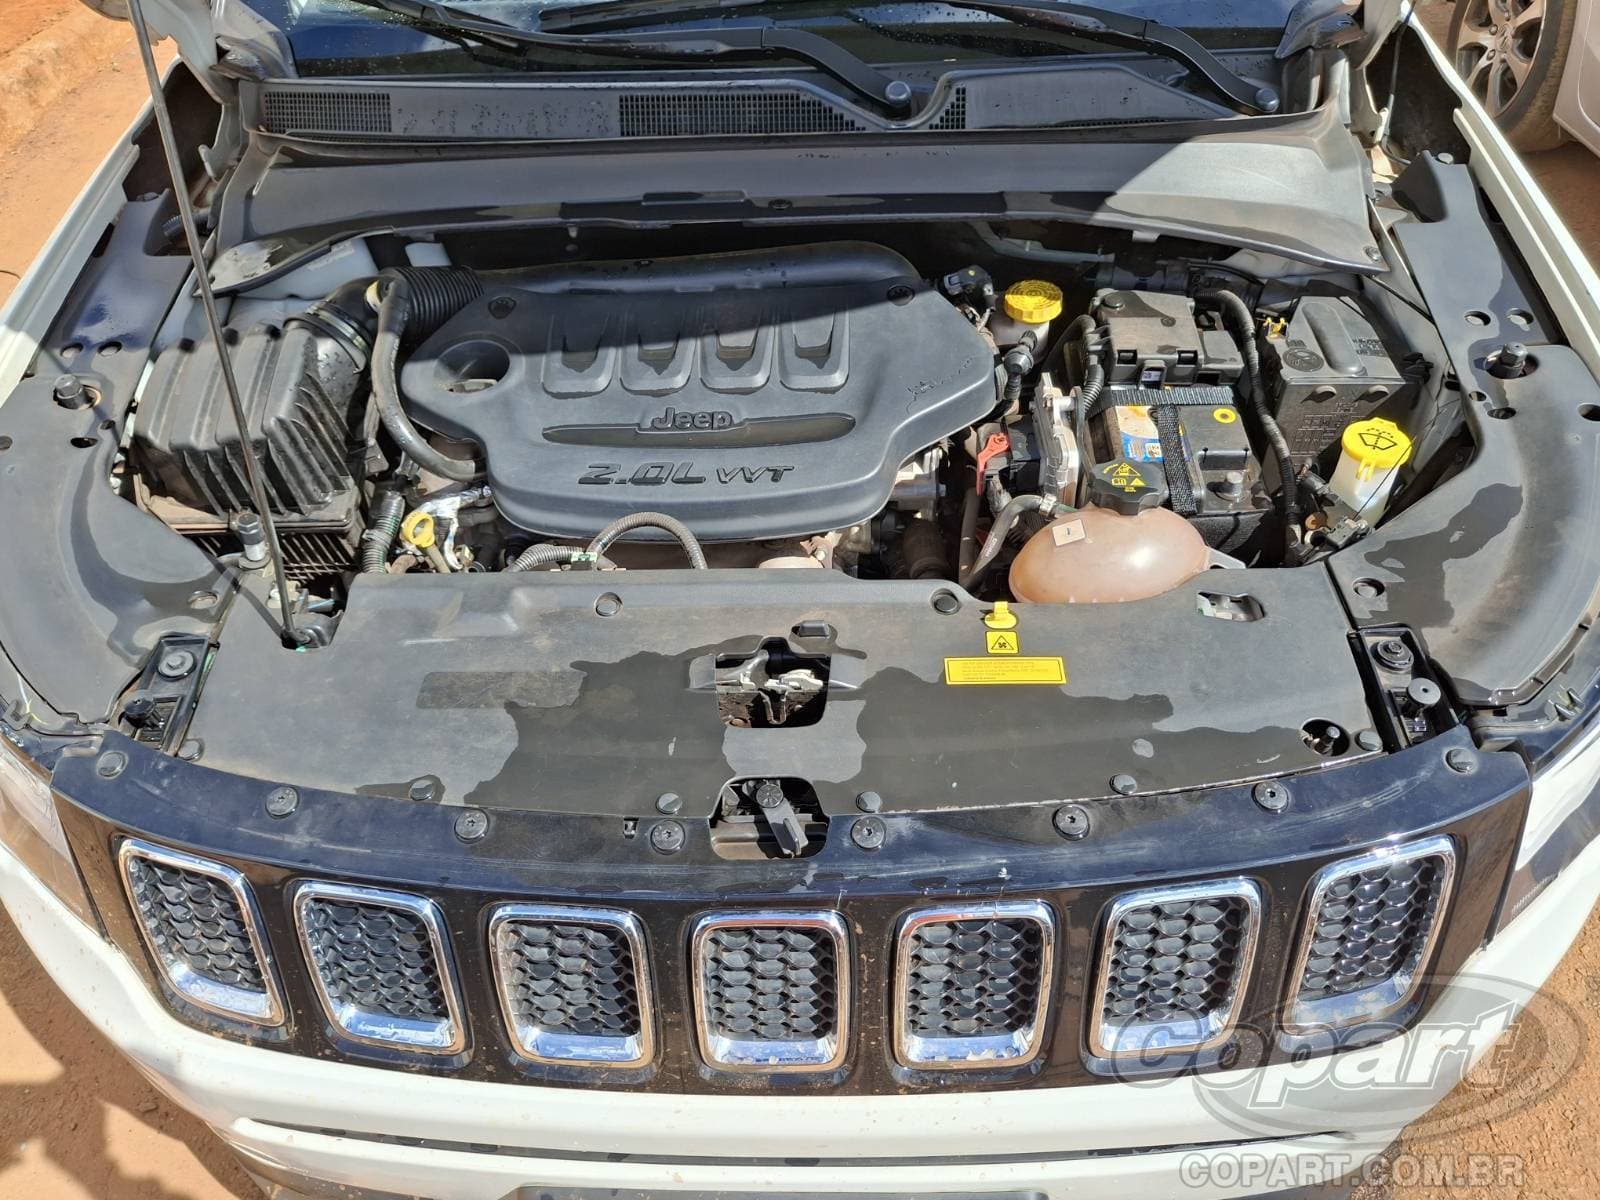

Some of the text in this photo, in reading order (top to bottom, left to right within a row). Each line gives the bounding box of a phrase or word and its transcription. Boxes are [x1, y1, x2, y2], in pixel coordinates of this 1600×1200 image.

[650, 406, 734, 430] Jeep
[578, 461, 795, 485] 2.0L VVT
